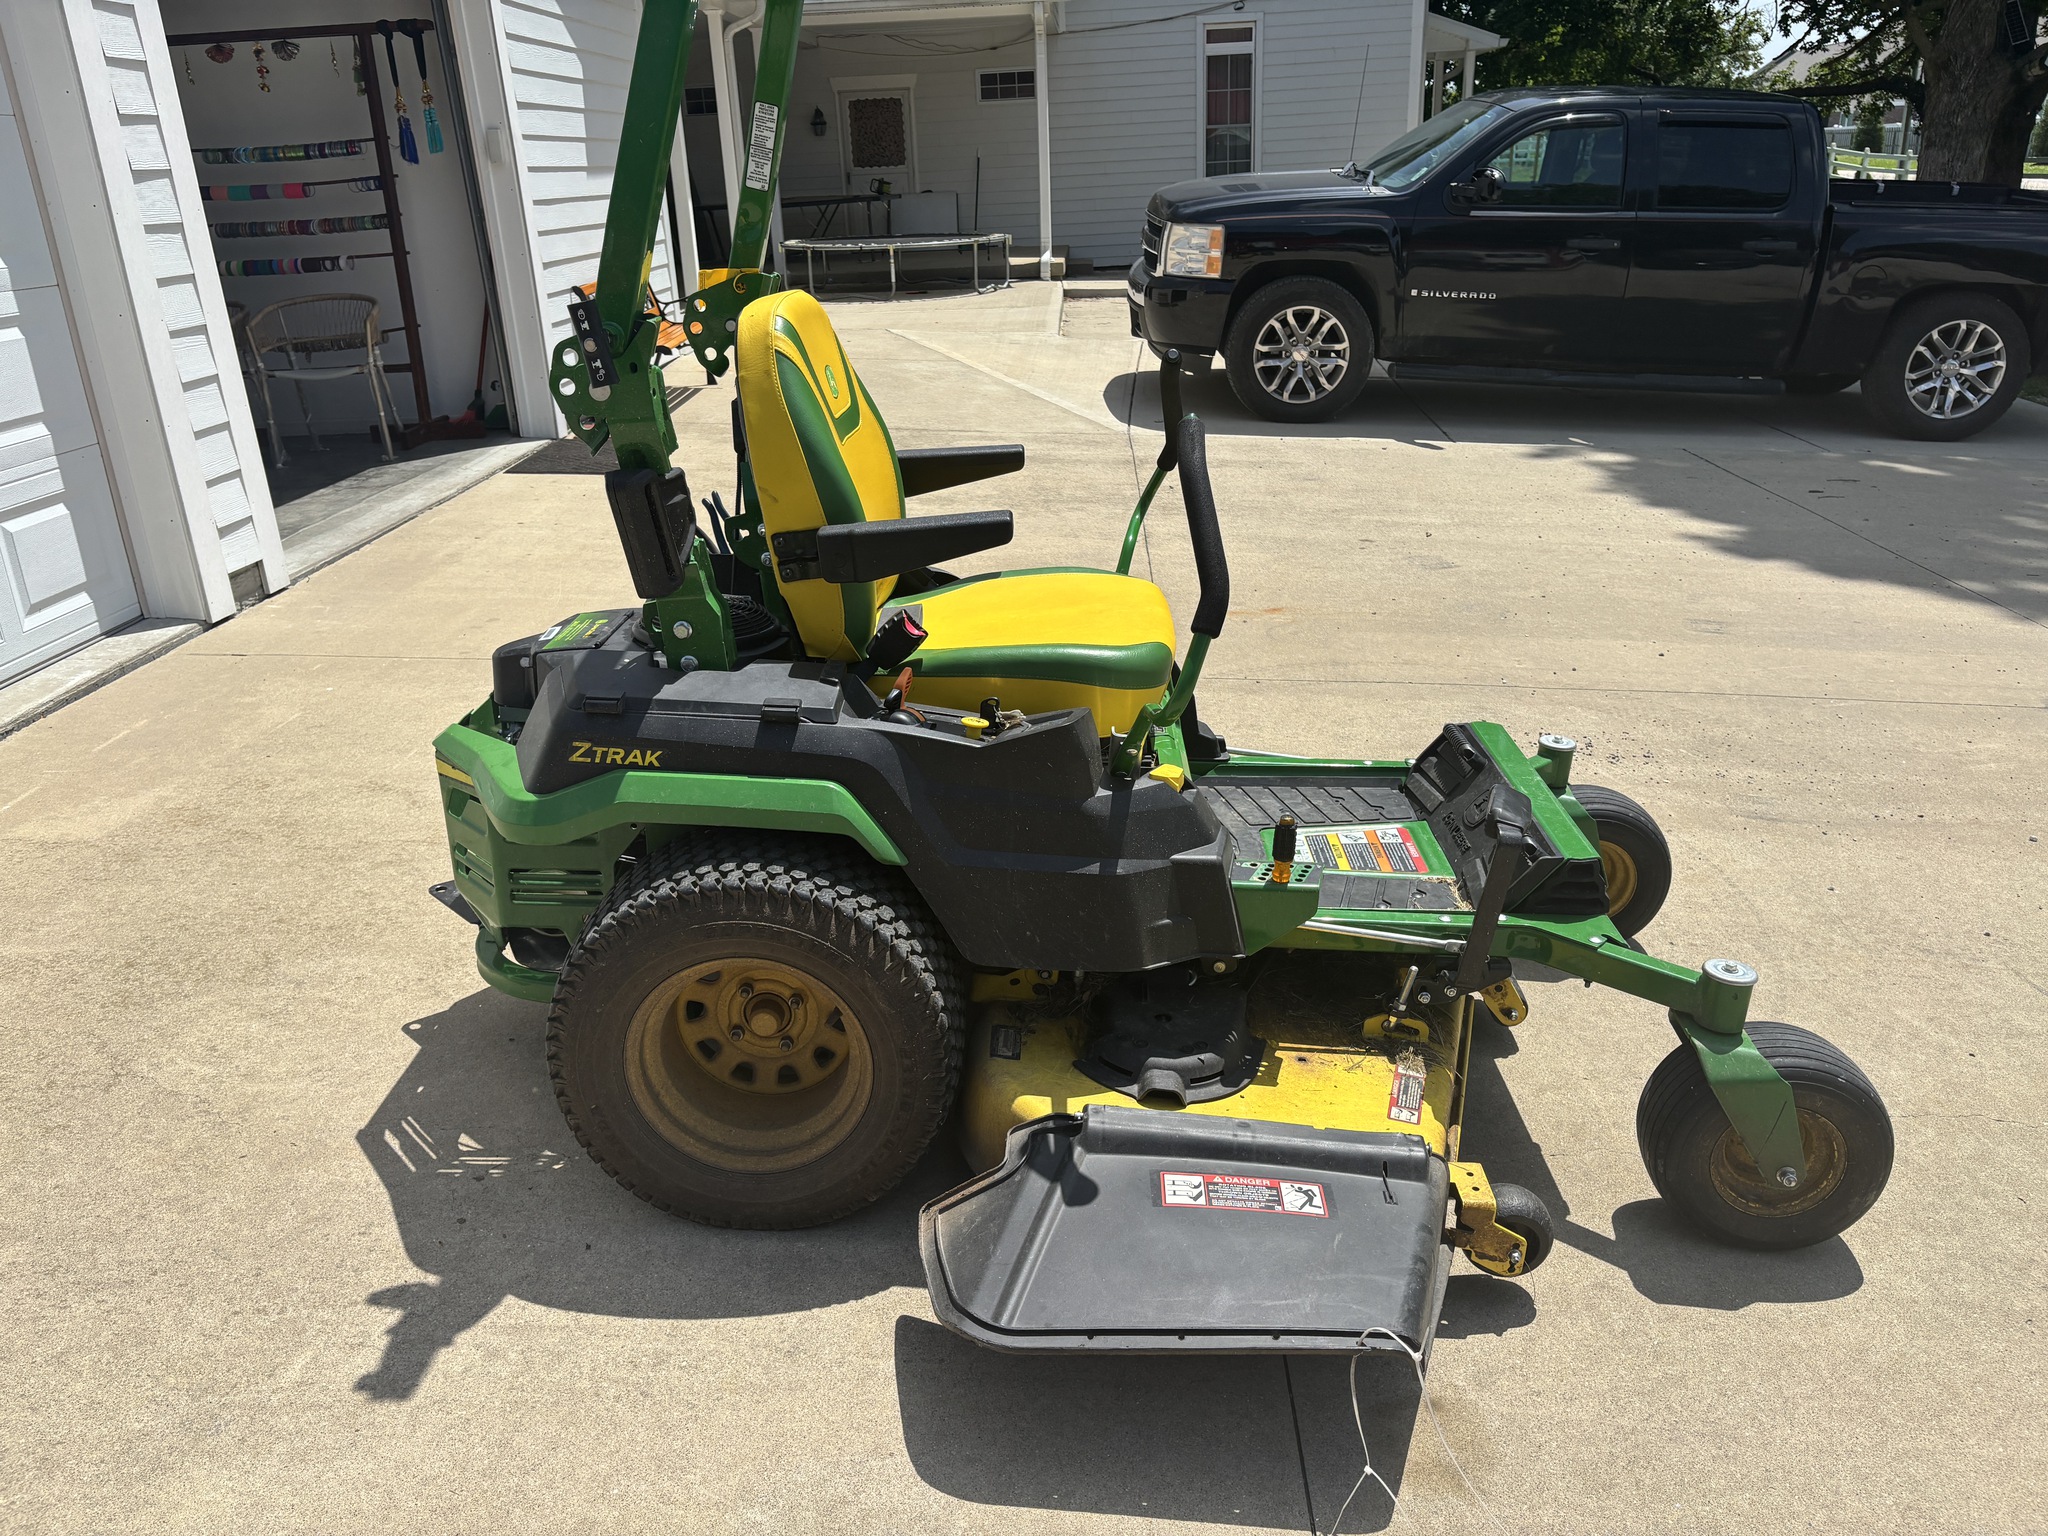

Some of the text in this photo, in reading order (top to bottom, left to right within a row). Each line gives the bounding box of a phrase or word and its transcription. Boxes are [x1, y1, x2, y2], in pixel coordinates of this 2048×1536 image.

[1420, 289, 1497, 300] SILVERADO
[568, 741, 663, 767] ZTRAK
[1224, 1176, 1270, 1186] DANGER
